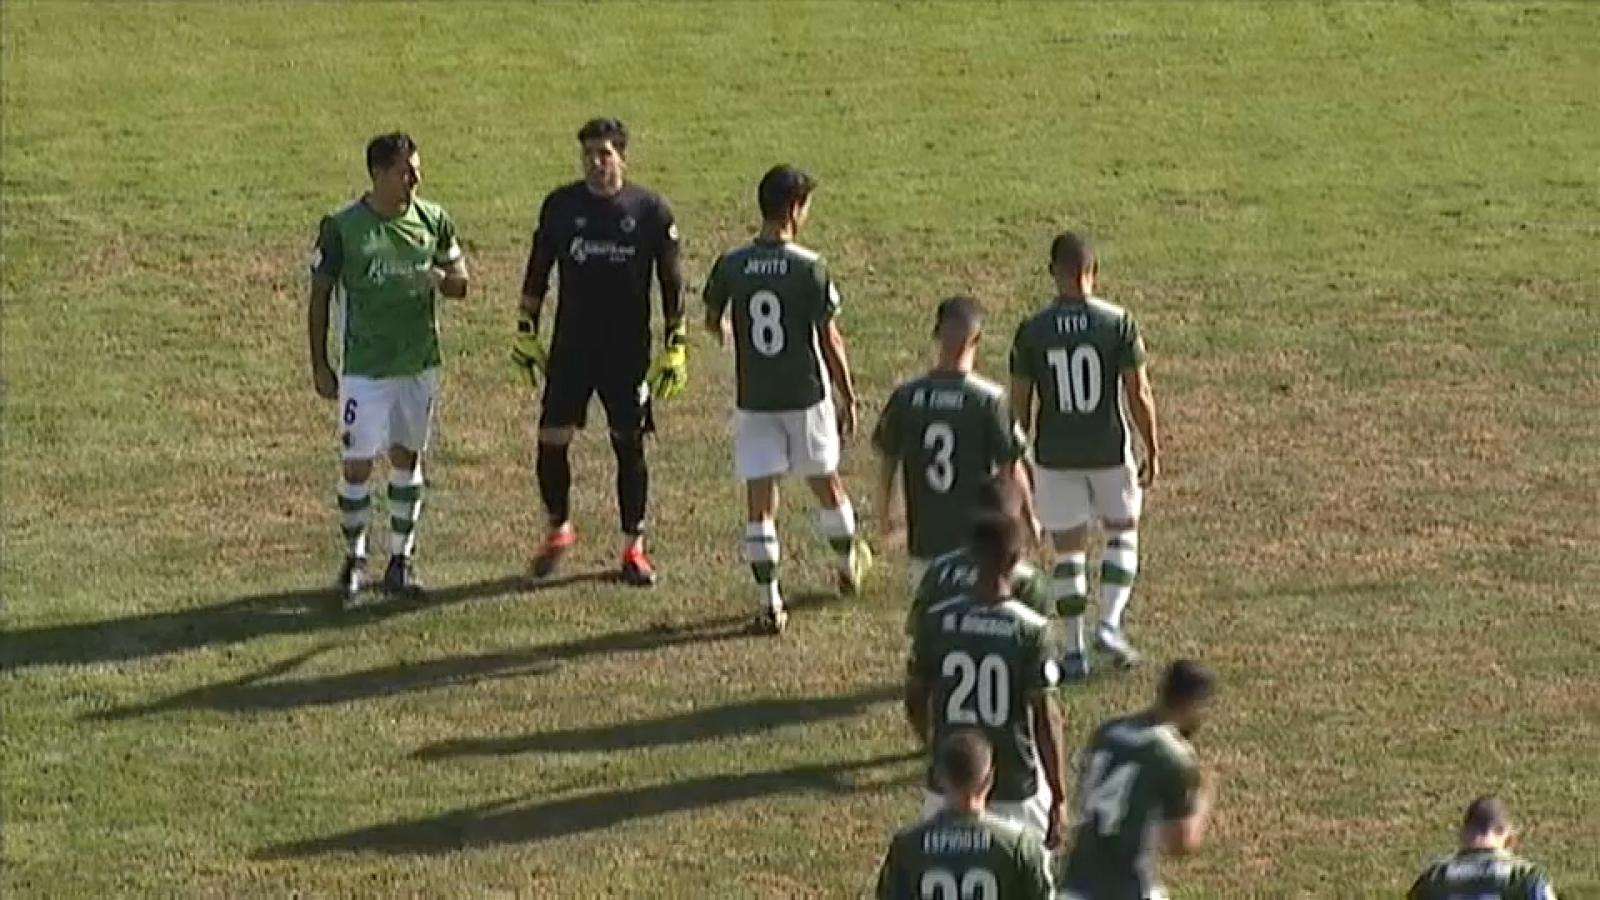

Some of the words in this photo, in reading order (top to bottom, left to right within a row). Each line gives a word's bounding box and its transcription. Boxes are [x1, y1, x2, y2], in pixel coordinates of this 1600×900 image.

[750, 290, 785, 356] 8
[344, 398, 357, 425] 6
[1046, 344, 1100, 413] 10
[924, 422, 954, 493] 3
[942, 652, 1009, 728] 20
